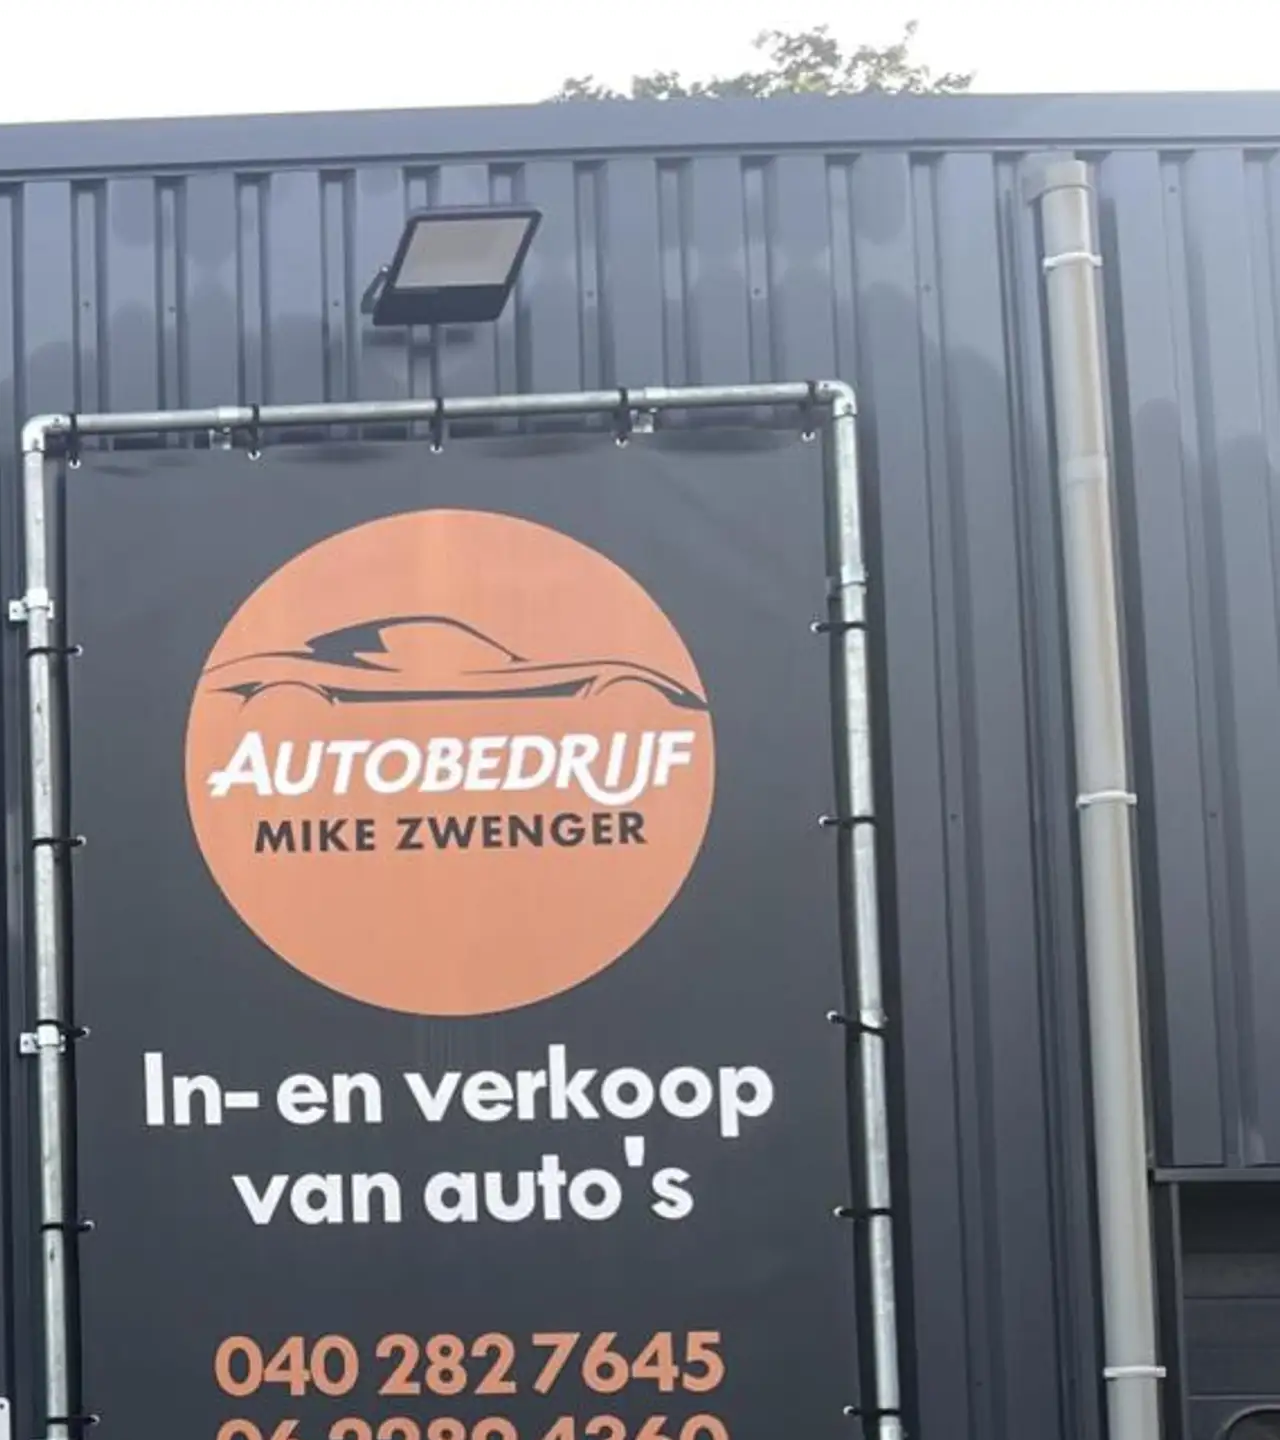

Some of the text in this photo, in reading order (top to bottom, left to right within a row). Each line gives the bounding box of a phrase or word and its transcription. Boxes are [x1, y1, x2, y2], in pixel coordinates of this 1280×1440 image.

[208, 730, 696, 806] AUTOBEDRIJF
[255, 811, 646, 853] MIKE ZWENGER
[144, 1043, 774, 1138] In- en verkoop
[231, 1135, 695, 1226] van auto's
[215, 1331, 726, 1397] 040 282 7645
